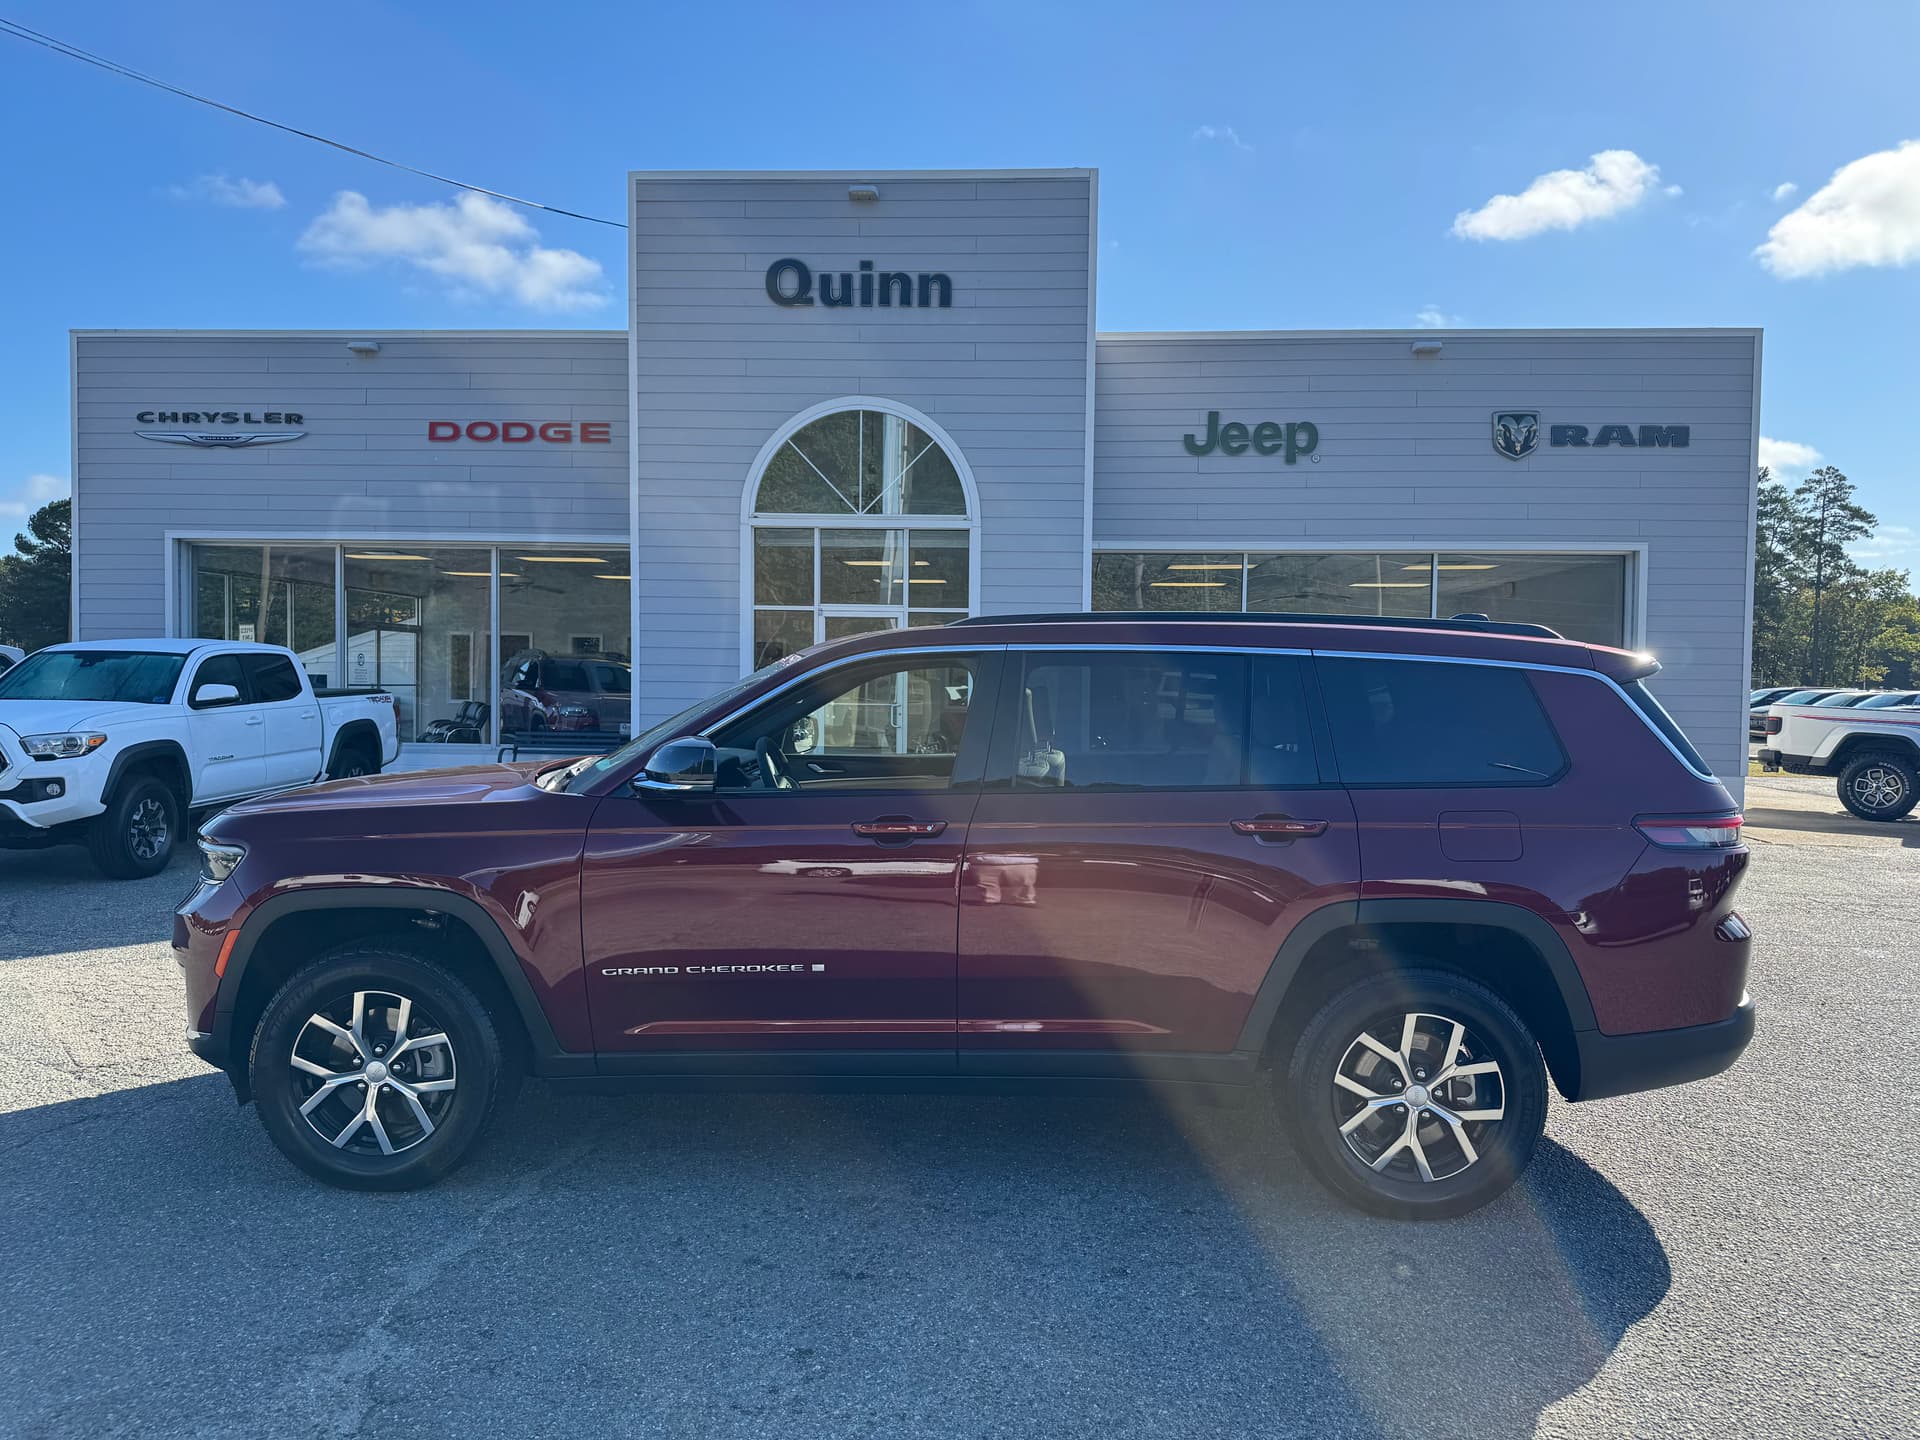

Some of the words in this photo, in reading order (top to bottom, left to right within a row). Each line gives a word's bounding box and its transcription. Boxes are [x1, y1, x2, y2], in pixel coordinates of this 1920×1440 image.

[765, 257, 952, 309] Quinn
[136, 411, 304, 425] CHRYSLER
[427, 421, 611, 444] DODGE
[1183, 410, 1318, 463] Jeep
[1550, 425, 1690, 447] RAM
[602, 967, 679, 976] GRAND
[686, 964, 804, 974] CHEROKEE
